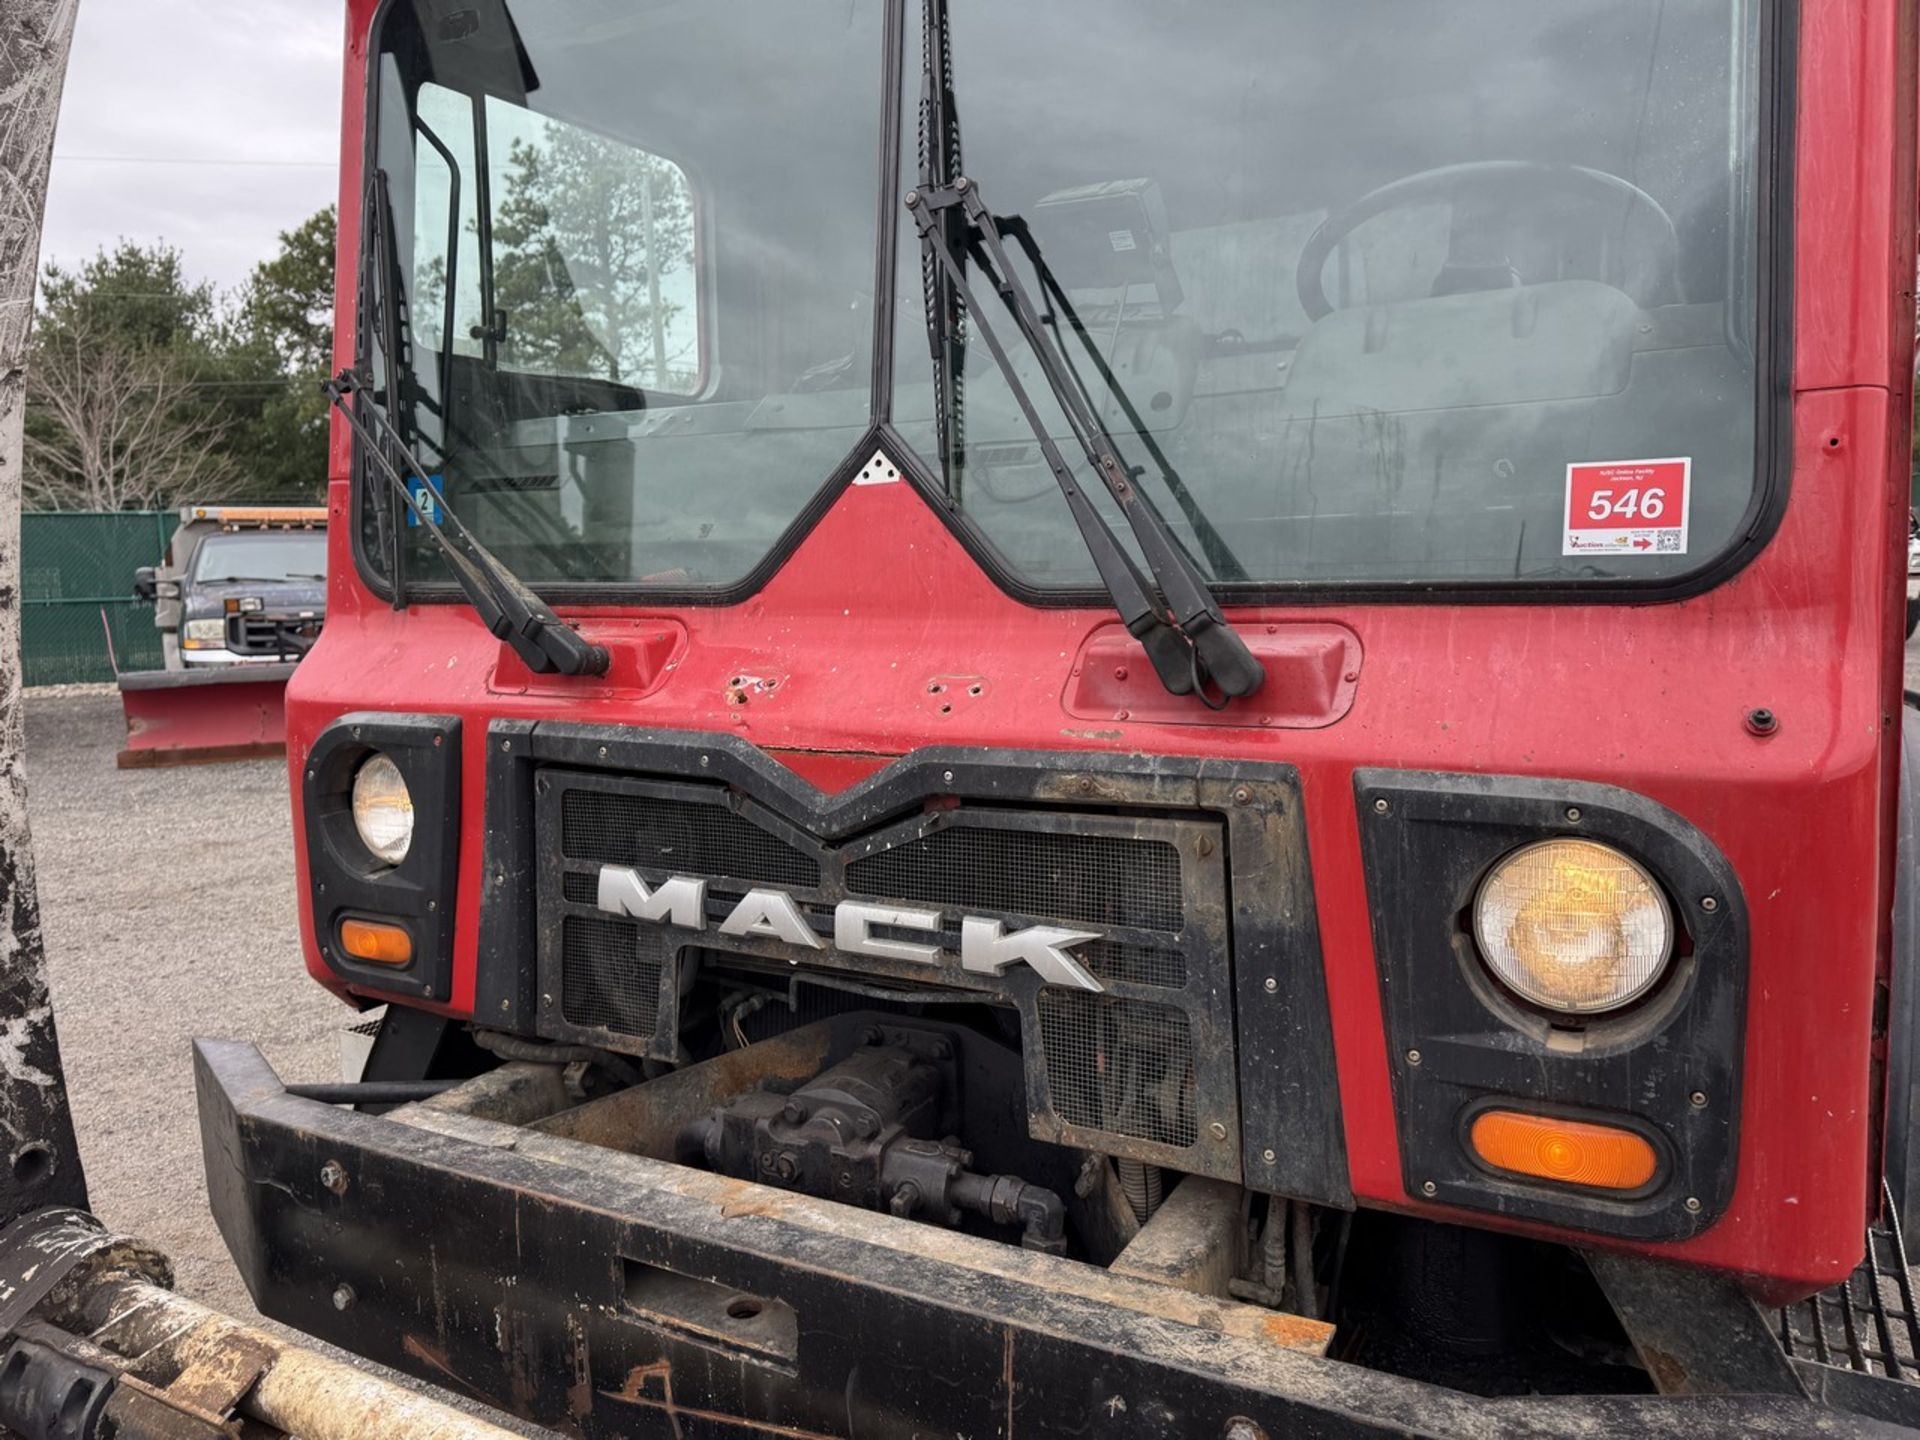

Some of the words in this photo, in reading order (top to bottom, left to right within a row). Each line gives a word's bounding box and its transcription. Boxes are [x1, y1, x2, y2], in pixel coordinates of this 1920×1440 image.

[420, 491, 429, 511] 2
[1588, 488, 1665, 520] 546
[597, 863, 1105, 993] MACK
